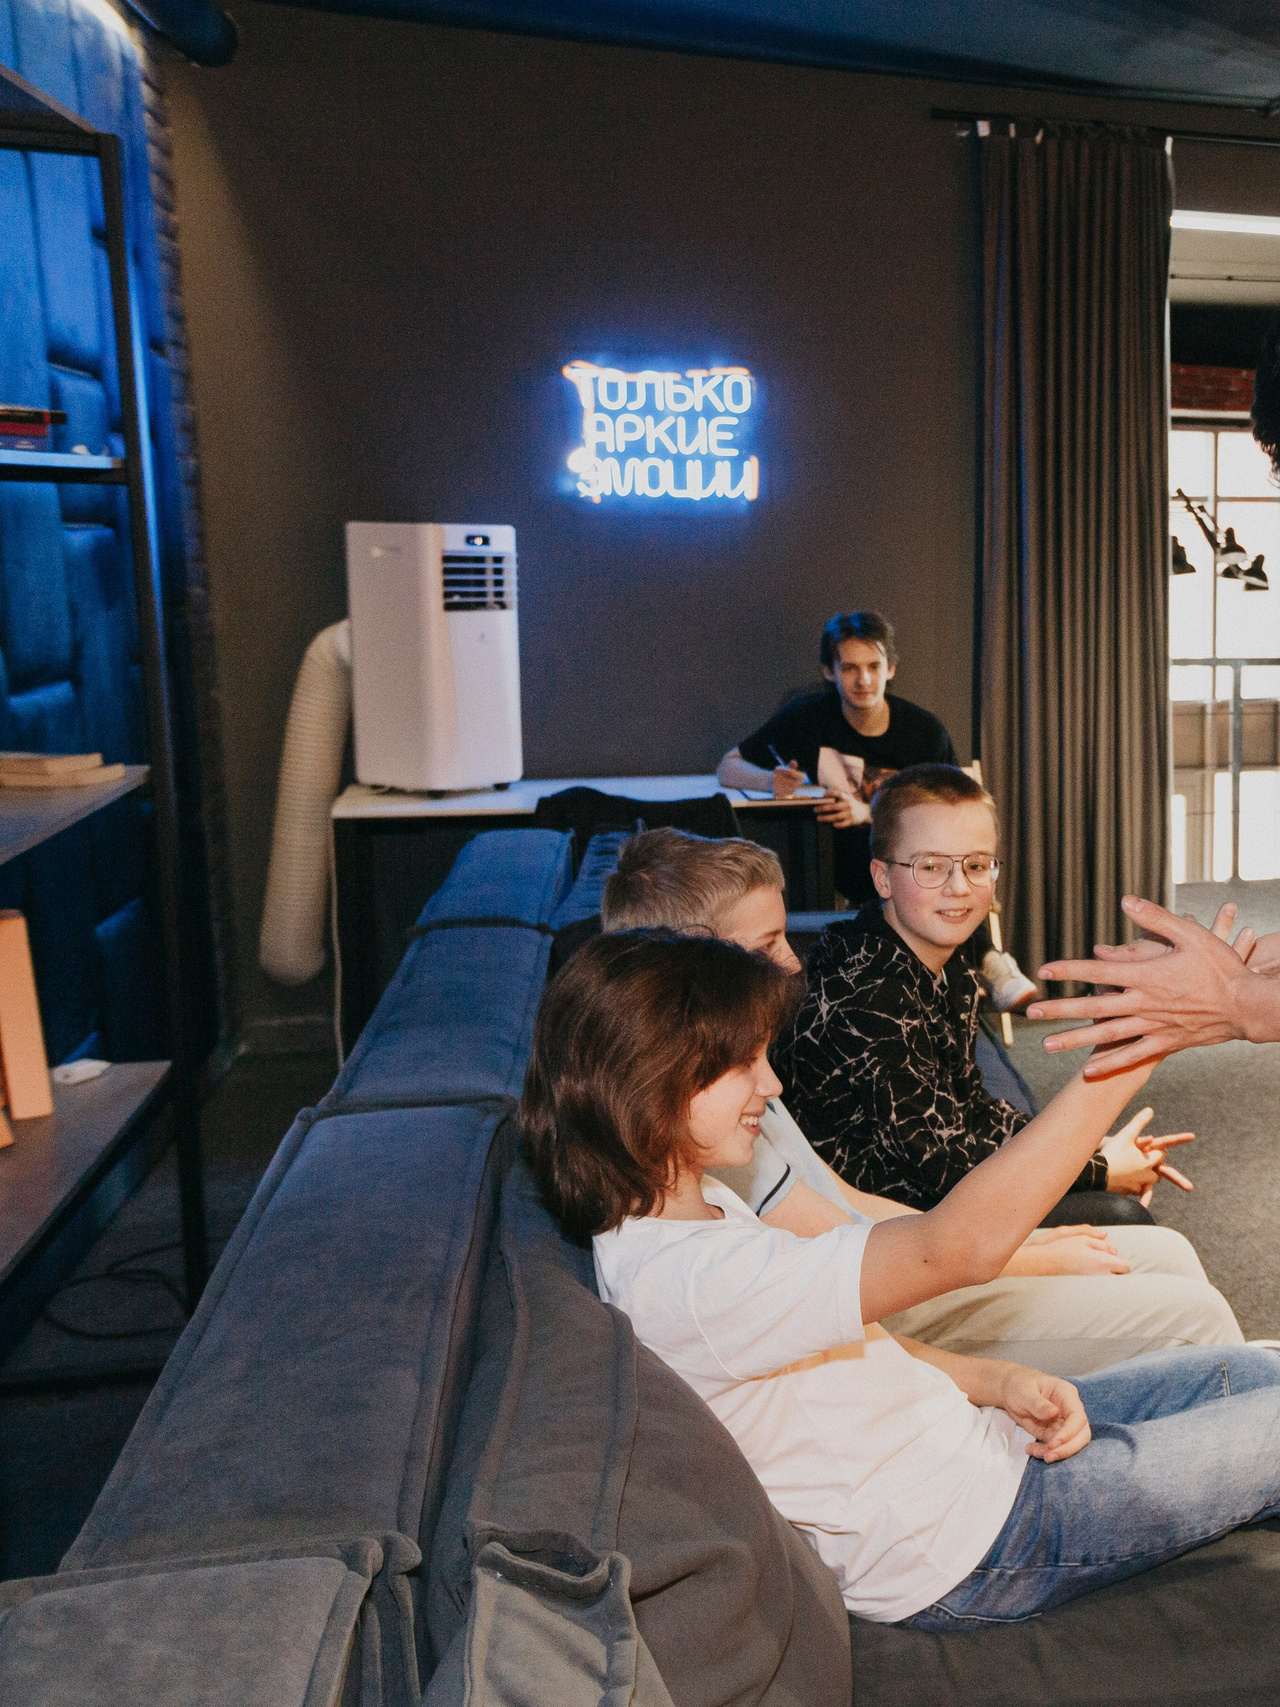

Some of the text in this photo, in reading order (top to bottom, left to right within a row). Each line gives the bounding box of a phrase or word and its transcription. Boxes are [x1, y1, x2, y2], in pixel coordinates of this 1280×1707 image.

[564, 367, 752, 413] ТОЛЬКО
[584, 413, 739, 456] ЯРКИЕ
[575, 456, 755, 500] ЭМОЦИИ
